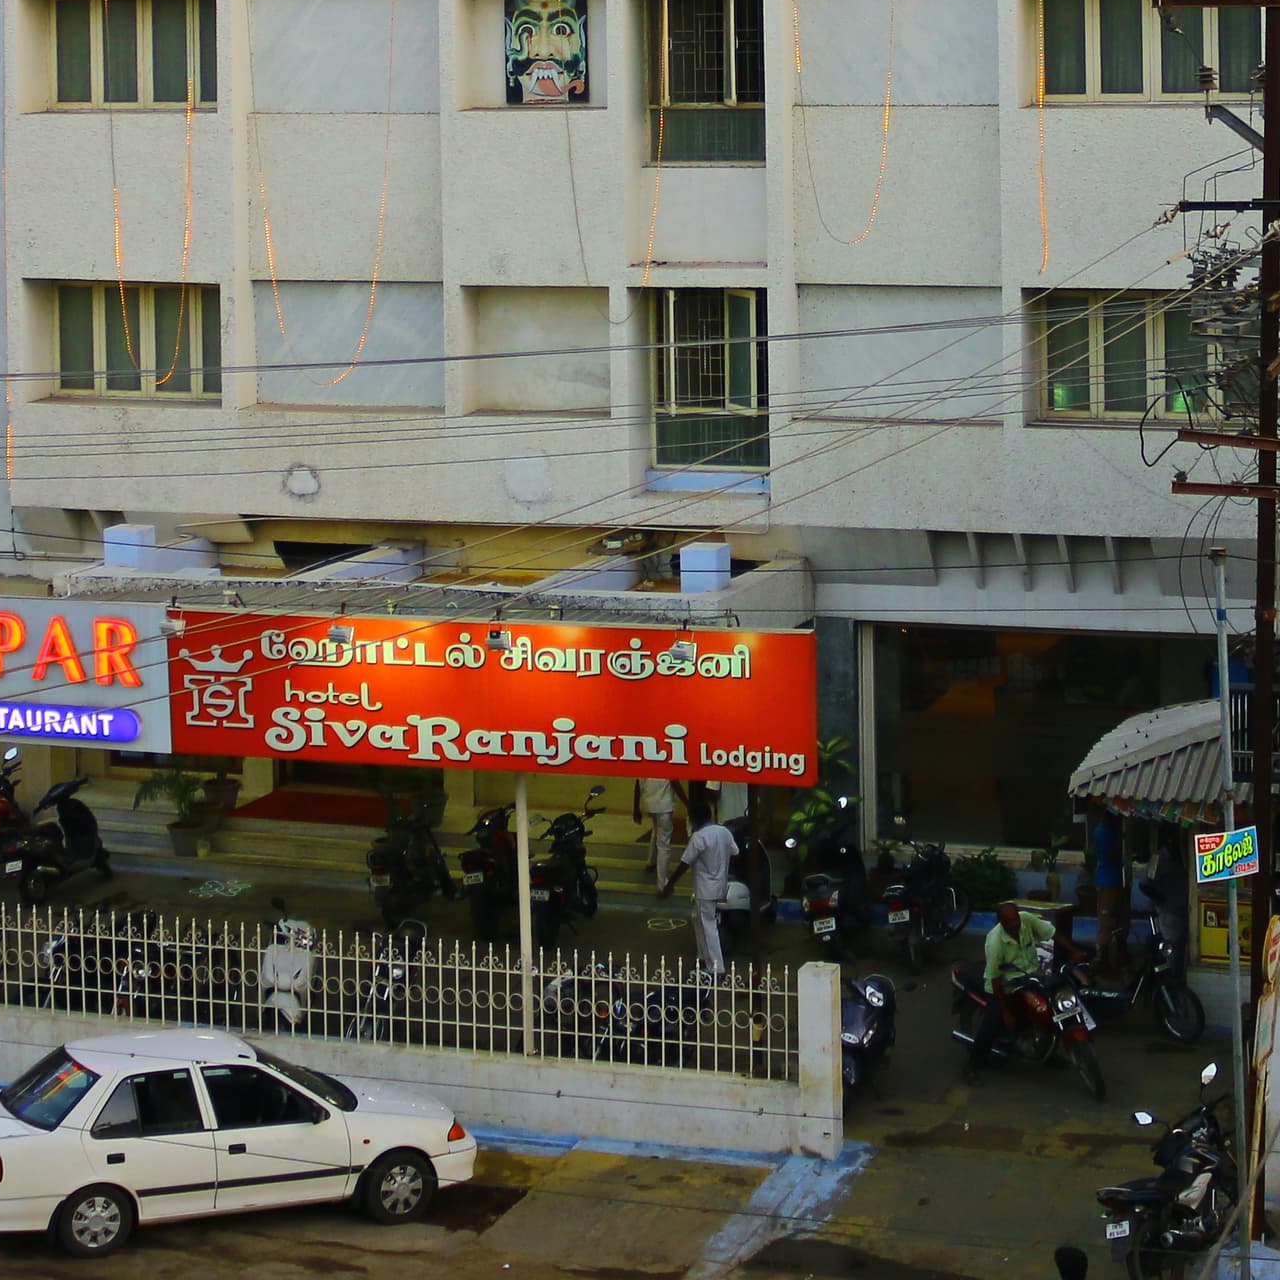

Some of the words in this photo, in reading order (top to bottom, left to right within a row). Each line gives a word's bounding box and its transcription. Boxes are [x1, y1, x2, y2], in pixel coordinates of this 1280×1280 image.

[285, 679, 383, 711] hotel
[700, 742, 806, 776] Lodging
[1202, 832, 1253, 876] காலேஜ்
